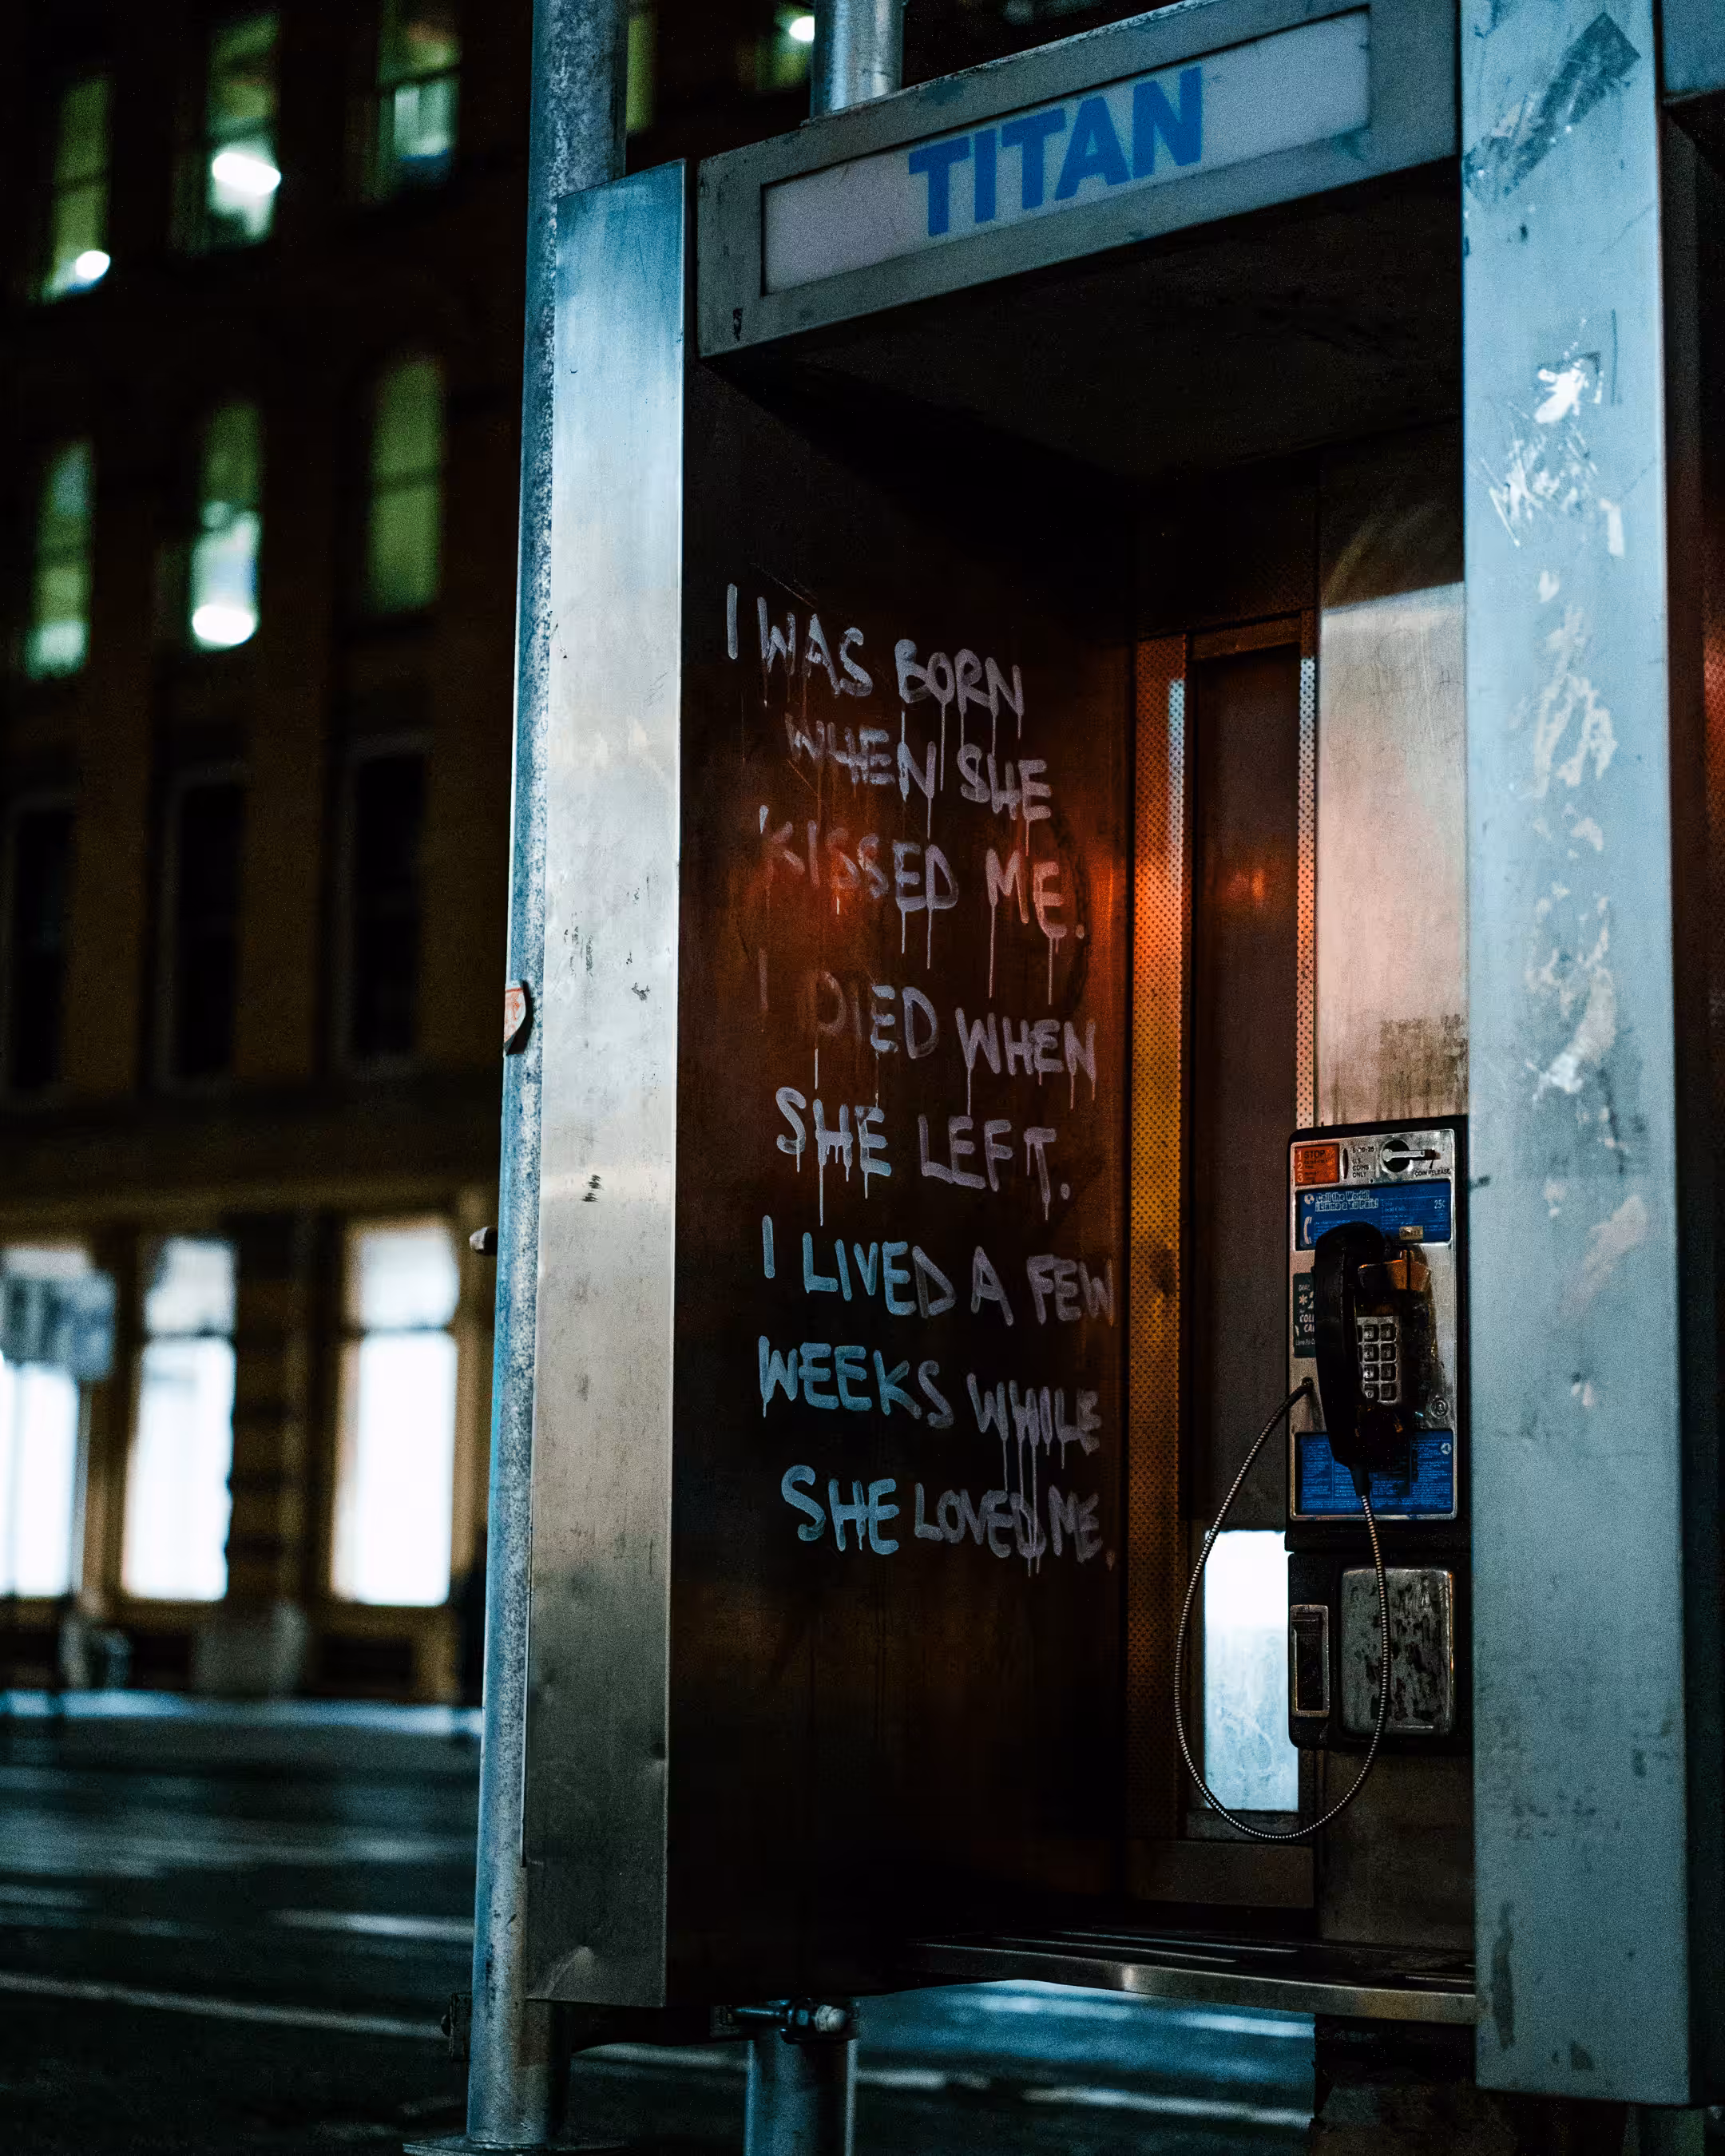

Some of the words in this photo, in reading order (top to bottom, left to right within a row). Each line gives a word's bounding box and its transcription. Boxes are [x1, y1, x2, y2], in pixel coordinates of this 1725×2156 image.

[908, 66, 1204, 237] TITAN
[727, 583, 738, 660] I
[757, 596, 874, 698] WAS
[894, 639, 1025, 717] BORN
[785, 713, 937, 801] WHEN
[958, 743, 1052, 821] SHE
[759, 948, 768, 1011] I
[807, 969, 938, 1060] DIED
[955, 1008, 1097, 1081] WHEN
[776, 1087, 893, 1179] SHE
[1297, 1162, 1303, 1171] 2
[1297, 1173, 1303, 1183] 3
[1316, 1192, 1331, 1203] Call
[1332, 1191, 1345, 1202] the
[763, 1215, 775, 1278] I
[803, 1232, 957, 1318] LIVED
[970, 1246, 1014, 1326] A
[1026, 1254, 1114, 1326] FEW
[759, 1336, 954, 1429] WEEKS
[966, 1373, 1102, 1456] WHILE
[781, 1465, 900, 1555] SHE
[915, 1483, 1045, 1560] LOVED
